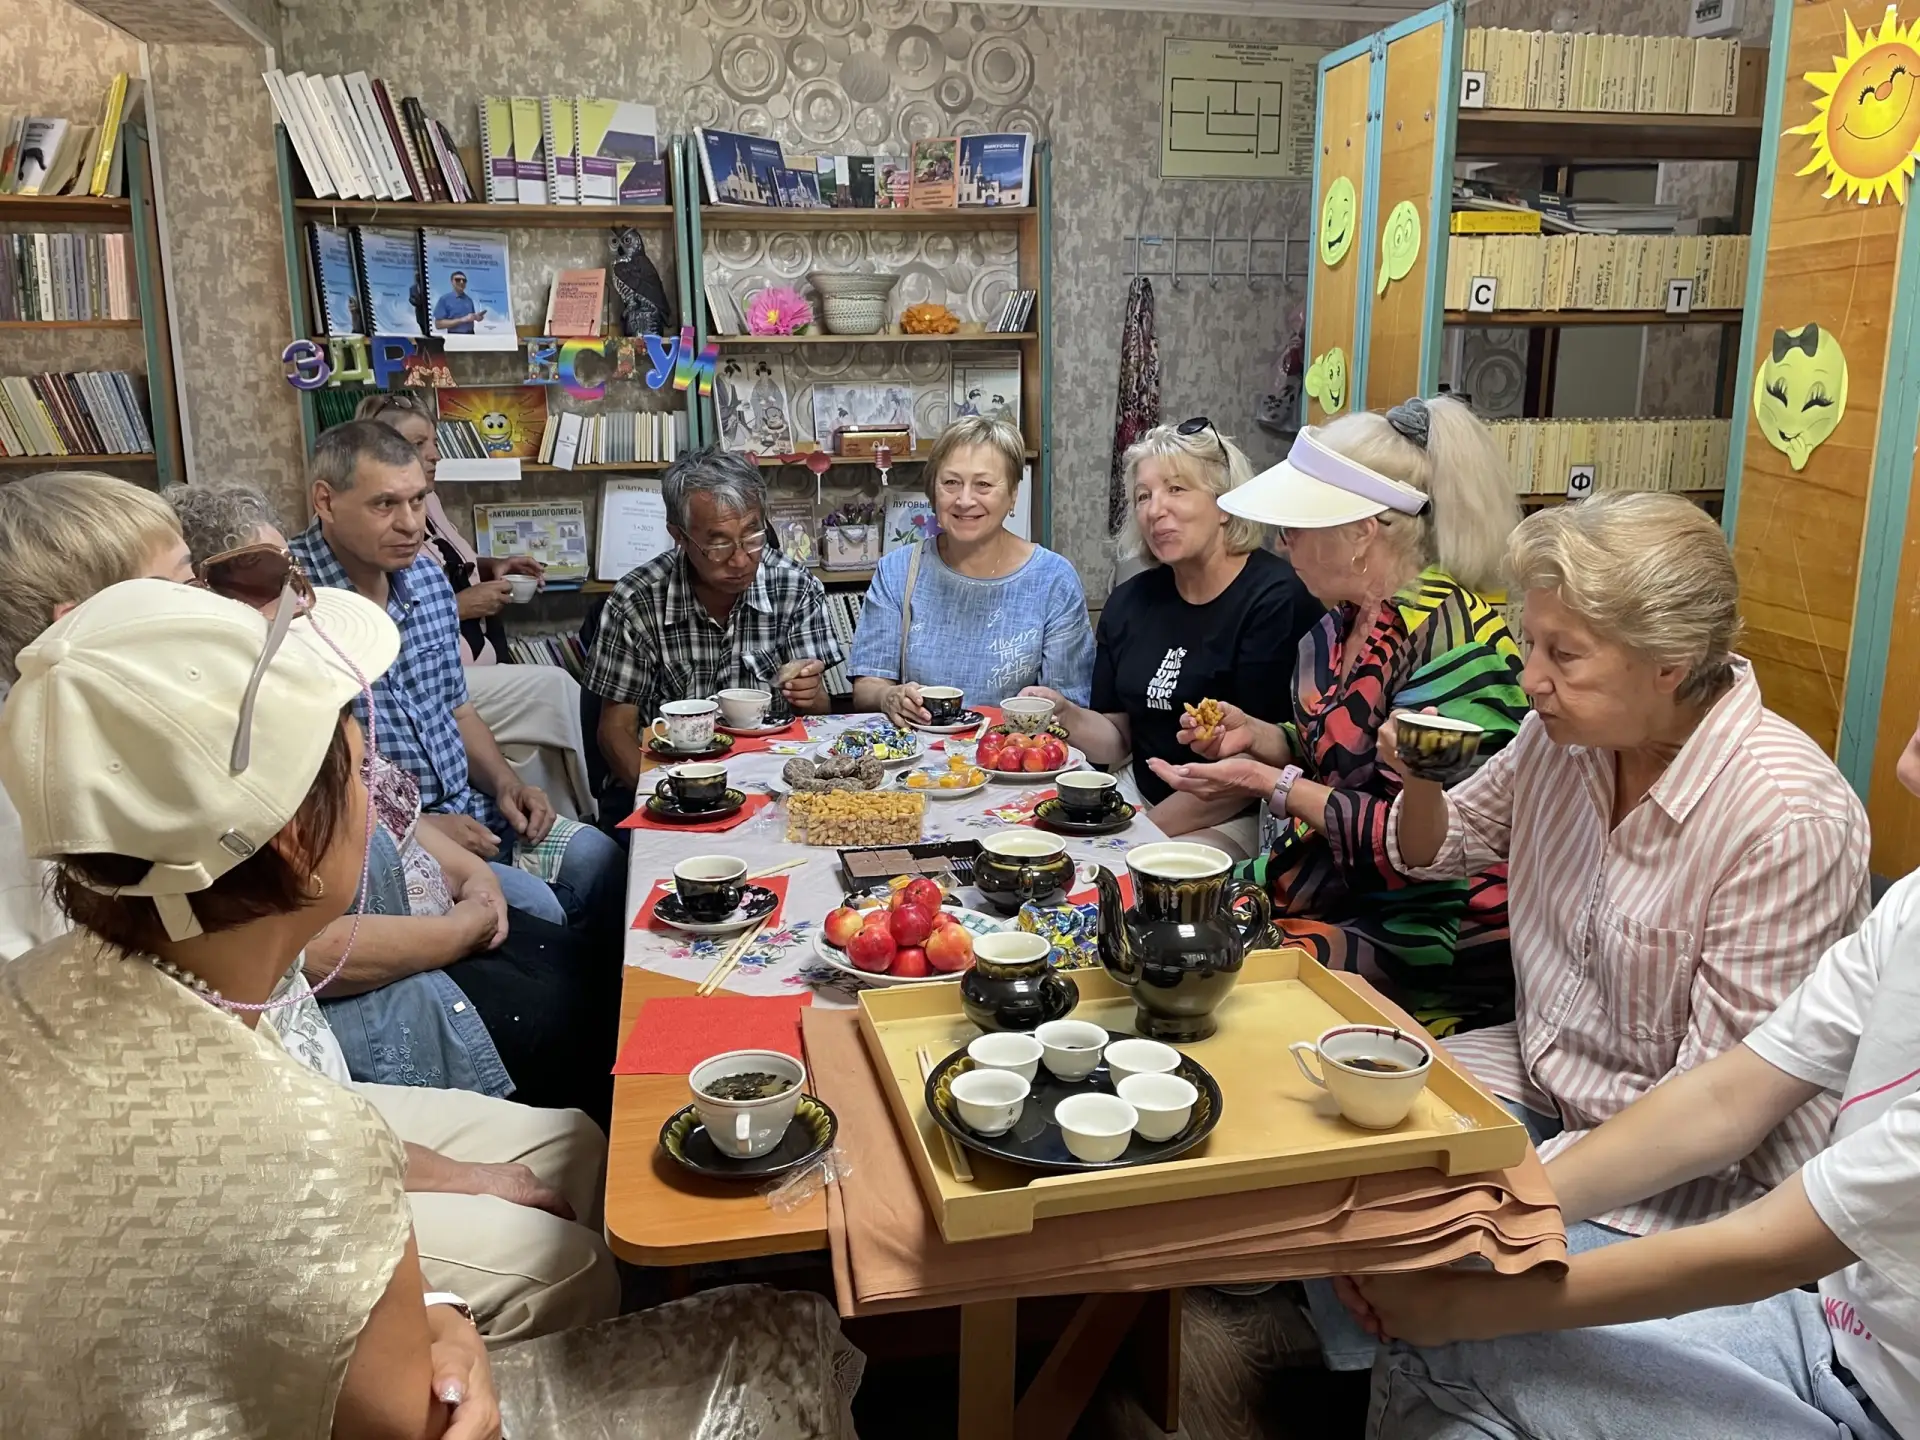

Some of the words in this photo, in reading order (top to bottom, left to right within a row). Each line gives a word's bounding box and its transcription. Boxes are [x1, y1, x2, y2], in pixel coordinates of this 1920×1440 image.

[1465, 79, 1481, 100] Р
[1673, 286, 1688, 307] Т
[1571, 472, 1591, 491] Ф
[488, 509, 530, 519] «АКТИВНОЕ
[531, 507, 582, 517] ДОЛГОЛЕТИЕ»
[985, 628, 1038, 651] ALWAYS
[993, 642, 1028, 662] THE
[991, 653, 1034, 678] SAME
[1160, 657, 1182, 670] talk
[1156, 668, 1180, 680] type
[1146, 685, 1173, 699] type
[1146, 697, 1173, 711] talk
